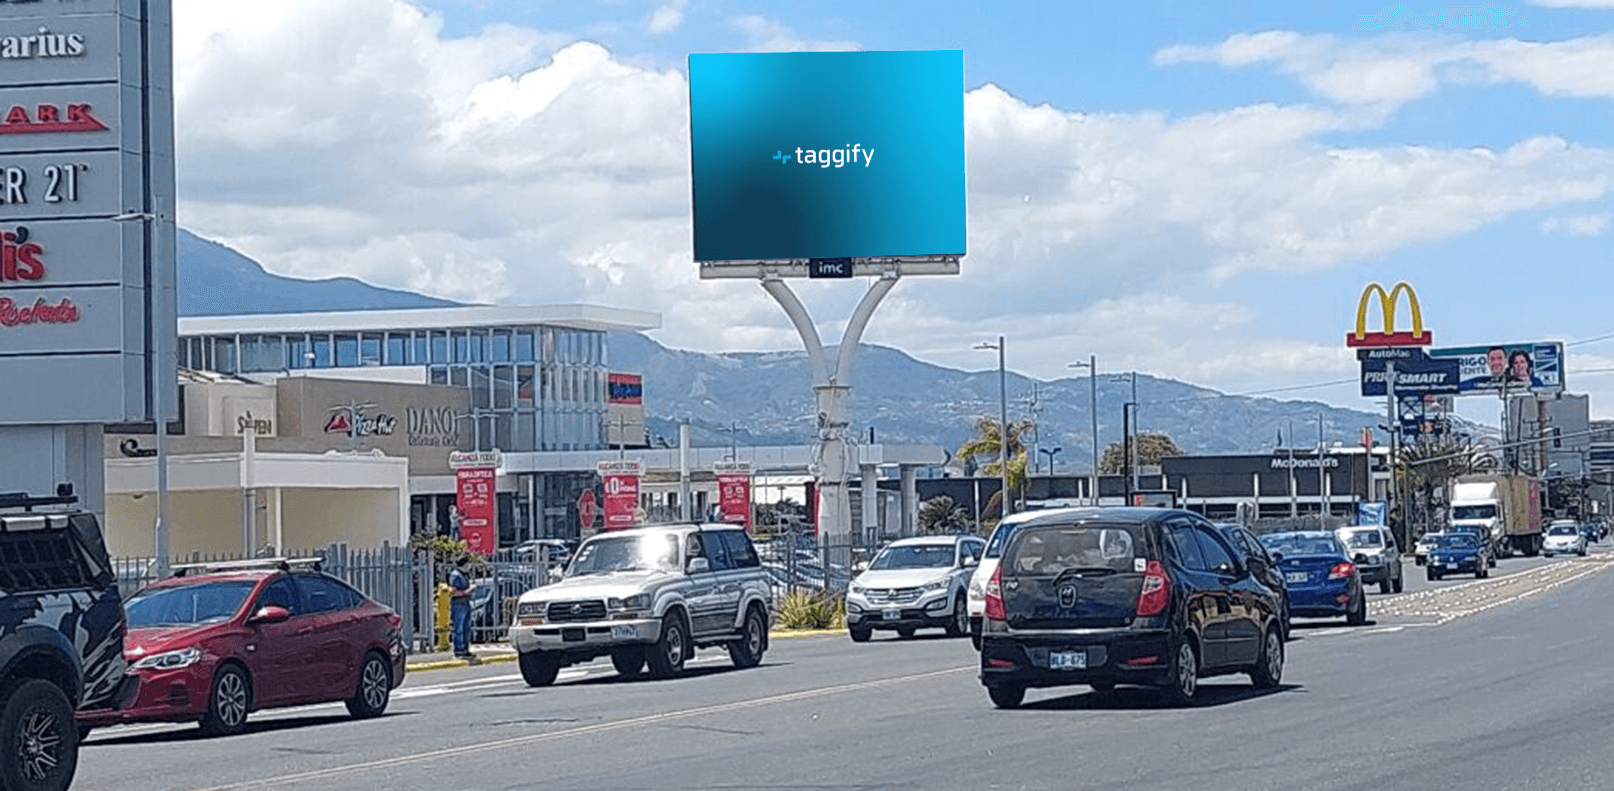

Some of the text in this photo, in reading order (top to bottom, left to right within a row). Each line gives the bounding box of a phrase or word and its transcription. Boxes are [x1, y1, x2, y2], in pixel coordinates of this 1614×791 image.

[0, 26, 85, 58] arius
[795, 143, 875, 168] taggify
[0, 226, 45, 281] i's
[818, 261, 843, 273] imc
[1368, 349, 1411, 358] AutoMac
[1271, 457, 1338, 468] McDonald's
